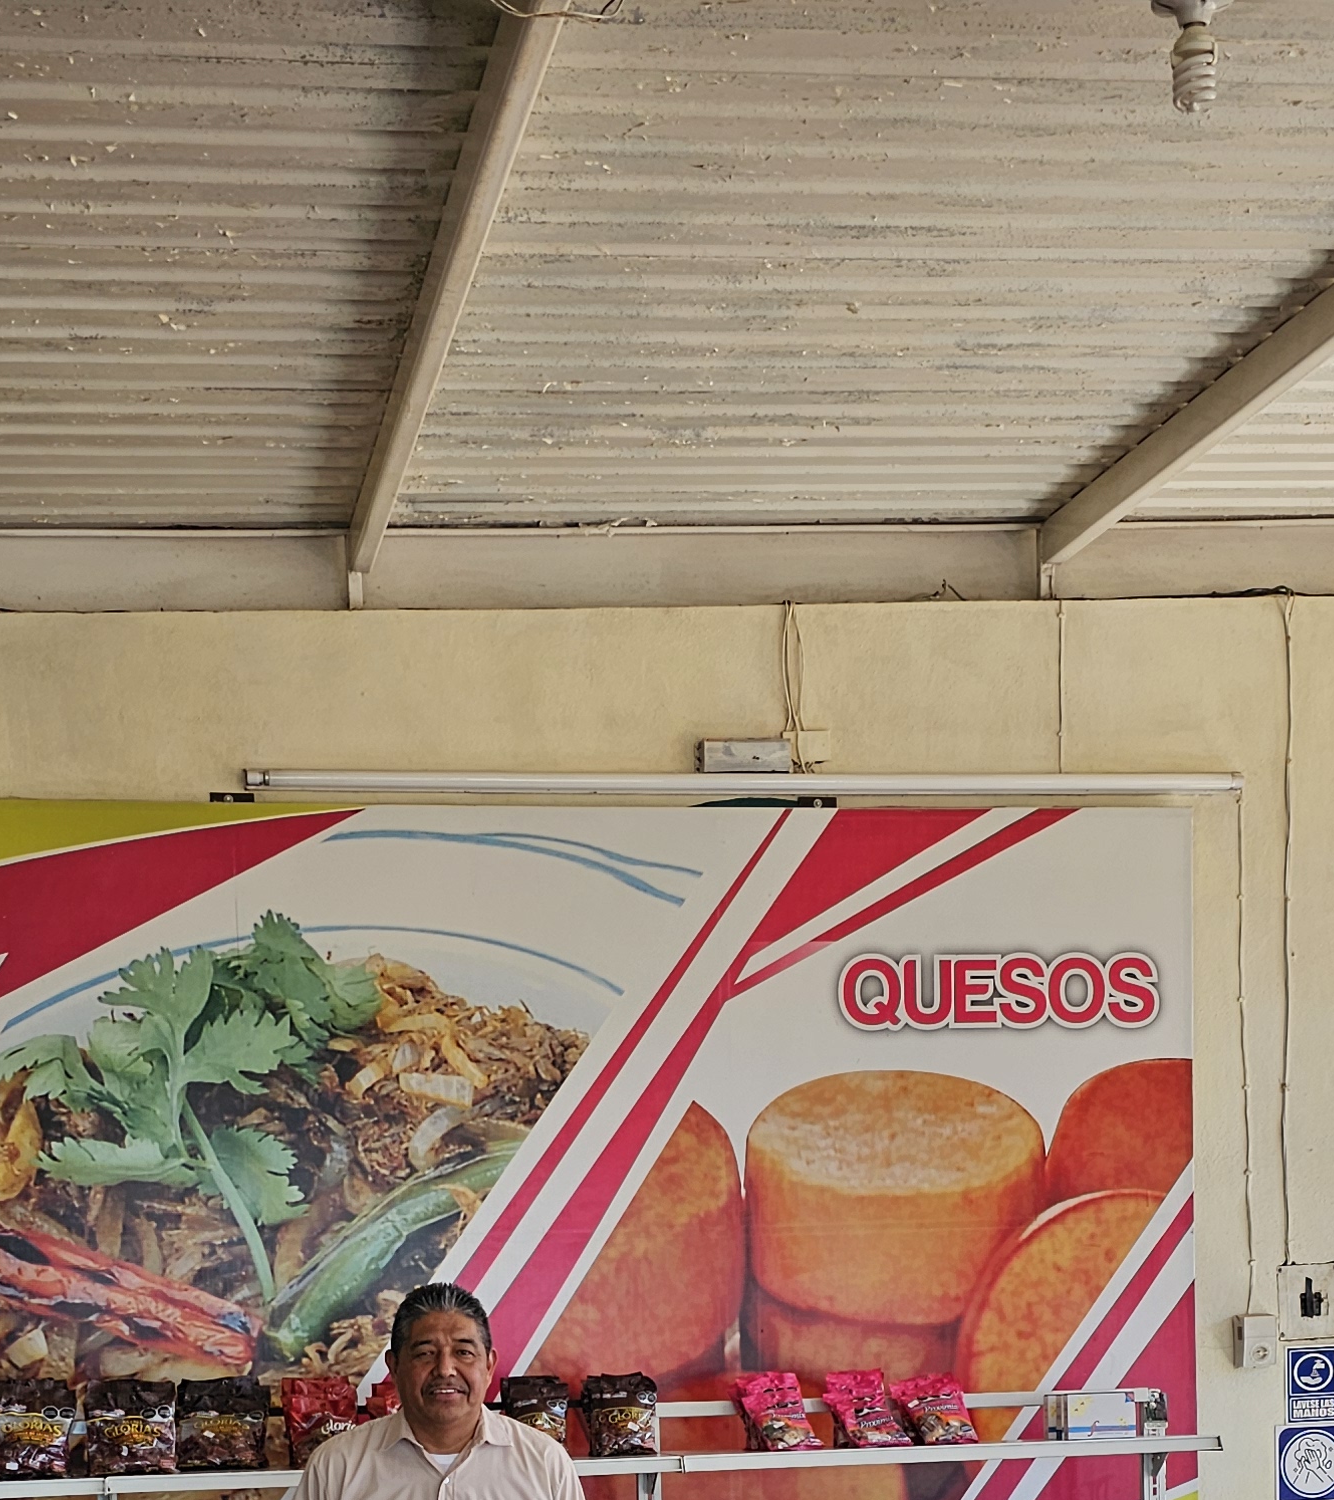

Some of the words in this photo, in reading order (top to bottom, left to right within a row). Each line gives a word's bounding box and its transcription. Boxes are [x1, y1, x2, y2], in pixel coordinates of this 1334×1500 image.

[838, 952, 1160, 1032] QUESOS
[1, 1418, 63, 1437] GLORIAS
[104, 1422, 163, 1439] GLORIAS
